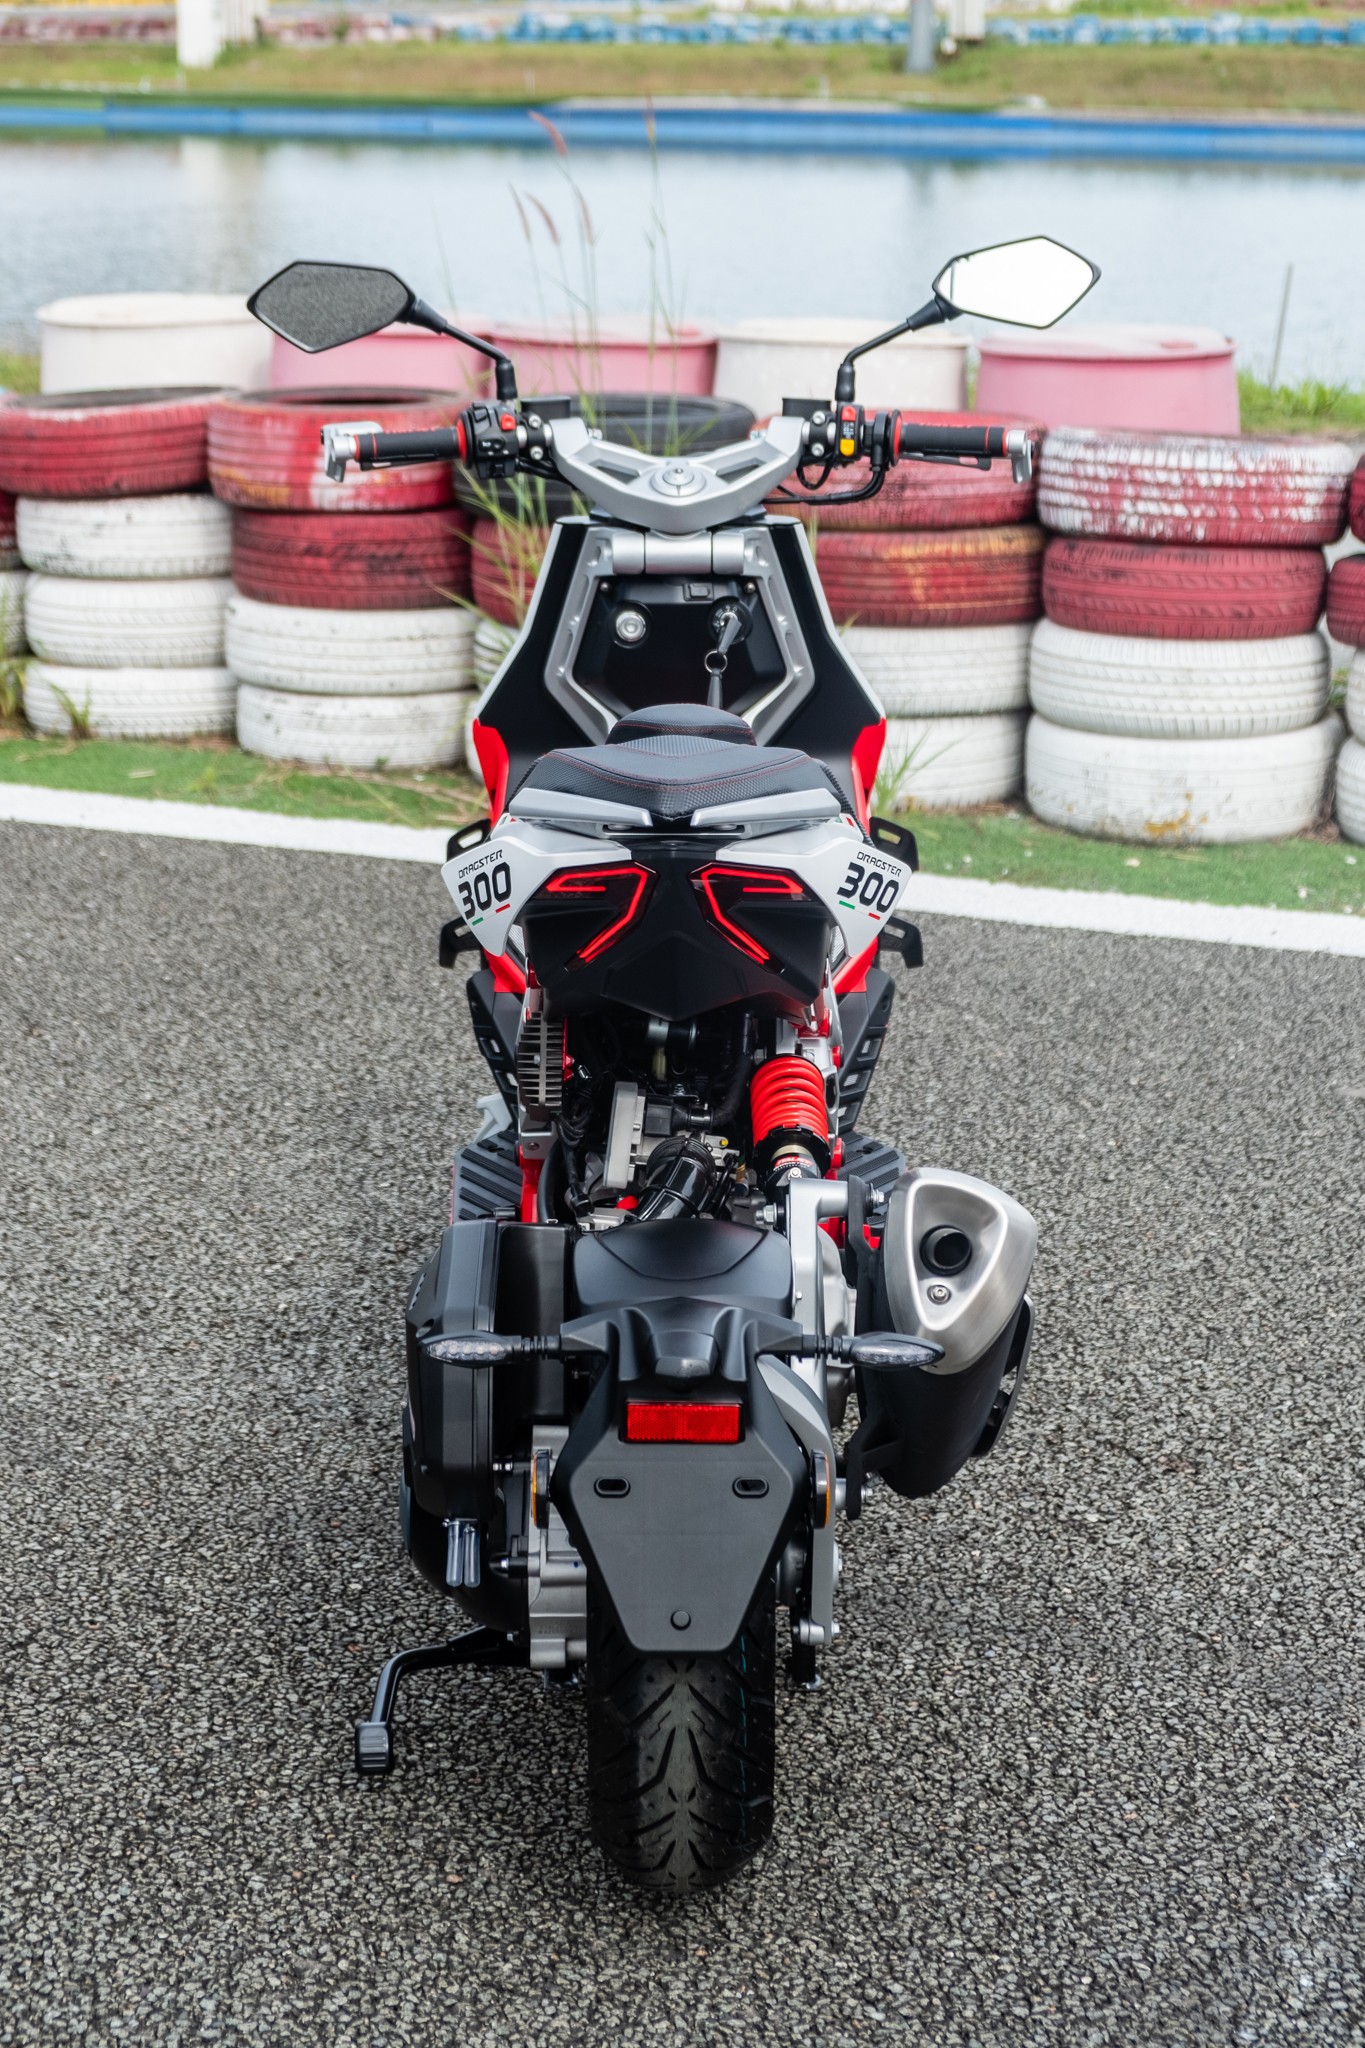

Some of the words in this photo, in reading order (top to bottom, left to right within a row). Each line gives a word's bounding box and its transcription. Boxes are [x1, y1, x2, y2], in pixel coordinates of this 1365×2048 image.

[458, 849, 503, 879] DRAGSTER
[856, 851, 902, 877] DRAGSTER
[458, 861, 512, 920] 300
[836, 861, 900, 913] 300
